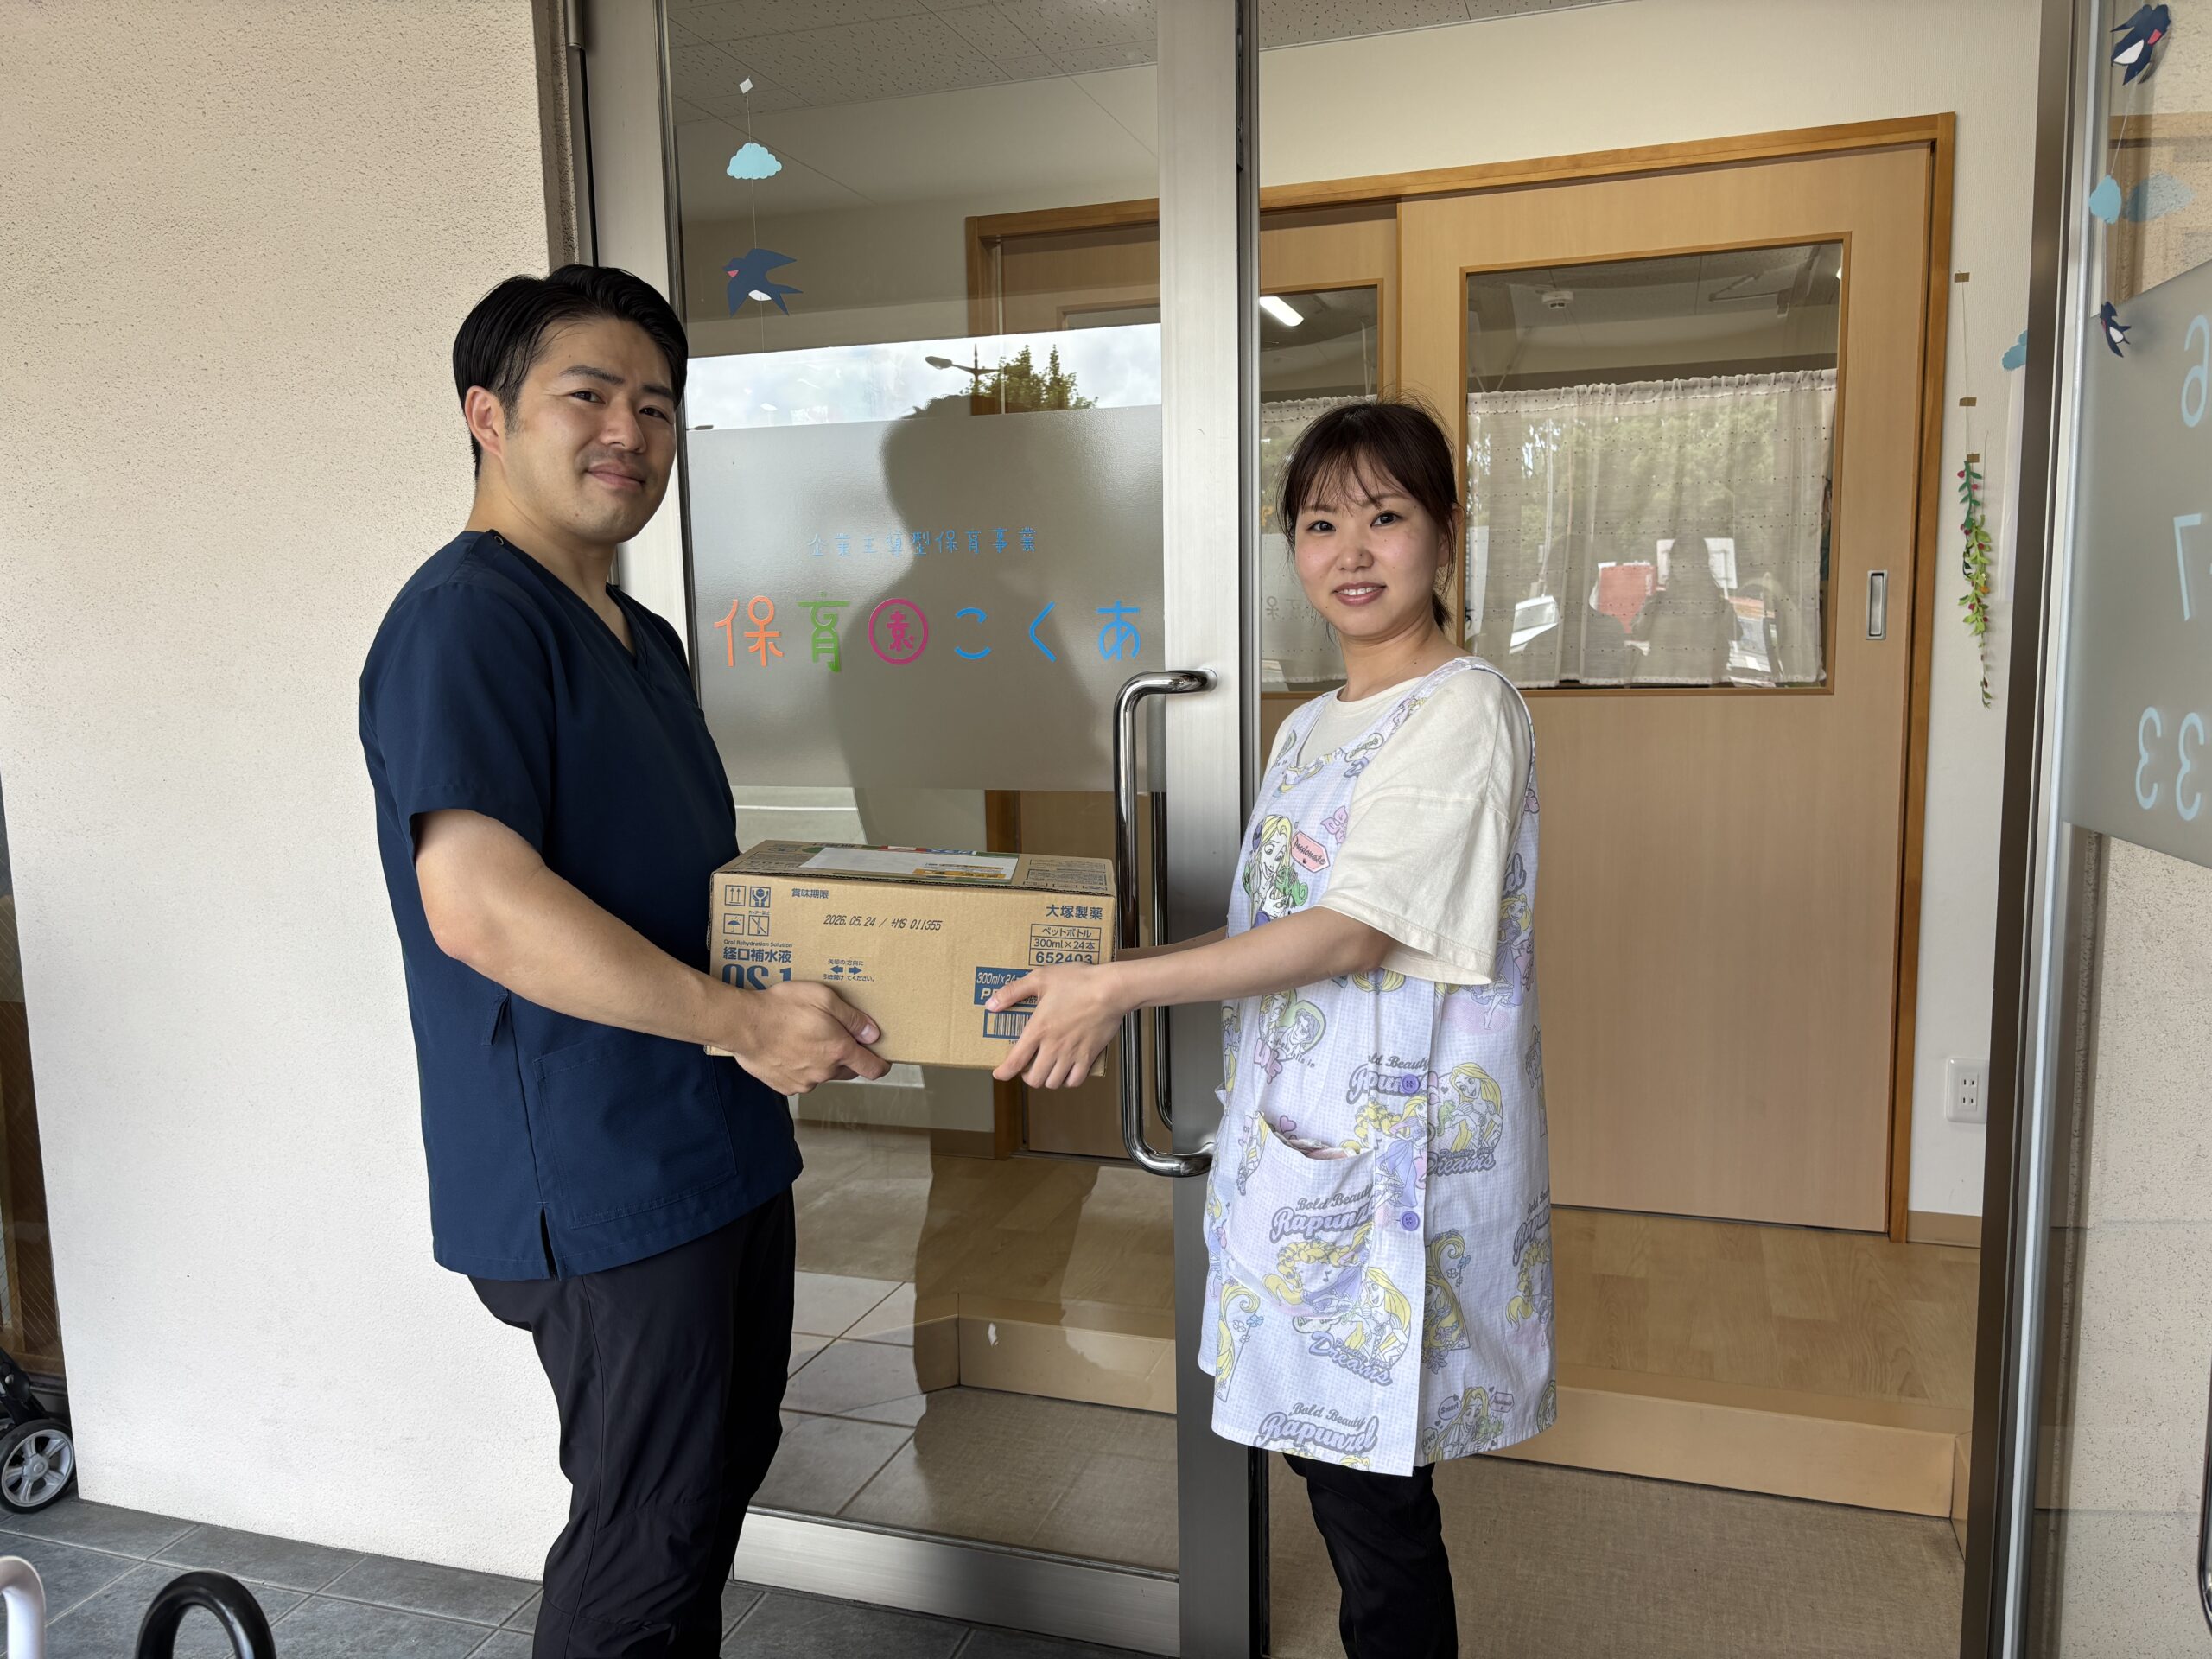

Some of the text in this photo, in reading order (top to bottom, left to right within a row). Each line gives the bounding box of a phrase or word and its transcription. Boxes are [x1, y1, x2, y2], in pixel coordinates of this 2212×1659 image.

[791, 888, 830, 899] 賞味期限
[1046, 904, 1103, 920] 大塚製薬
[910, 919, 944, 931] 011355
[1041, 926, 1092, 938] ペットボトル
[735, 940, 769, 949] Rehydration
[722, 946, 792, 963] 経口補水液
[1035, 951, 1093, 964] 652403
[1296, 1198, 1329, 1211] Bold
[1308, 1331, 1394, 1387] Dreams
[1288, 1402, 1366, 1432] Bold Beauty
[1253, 1411, 1380, 1454] Rapunzel
